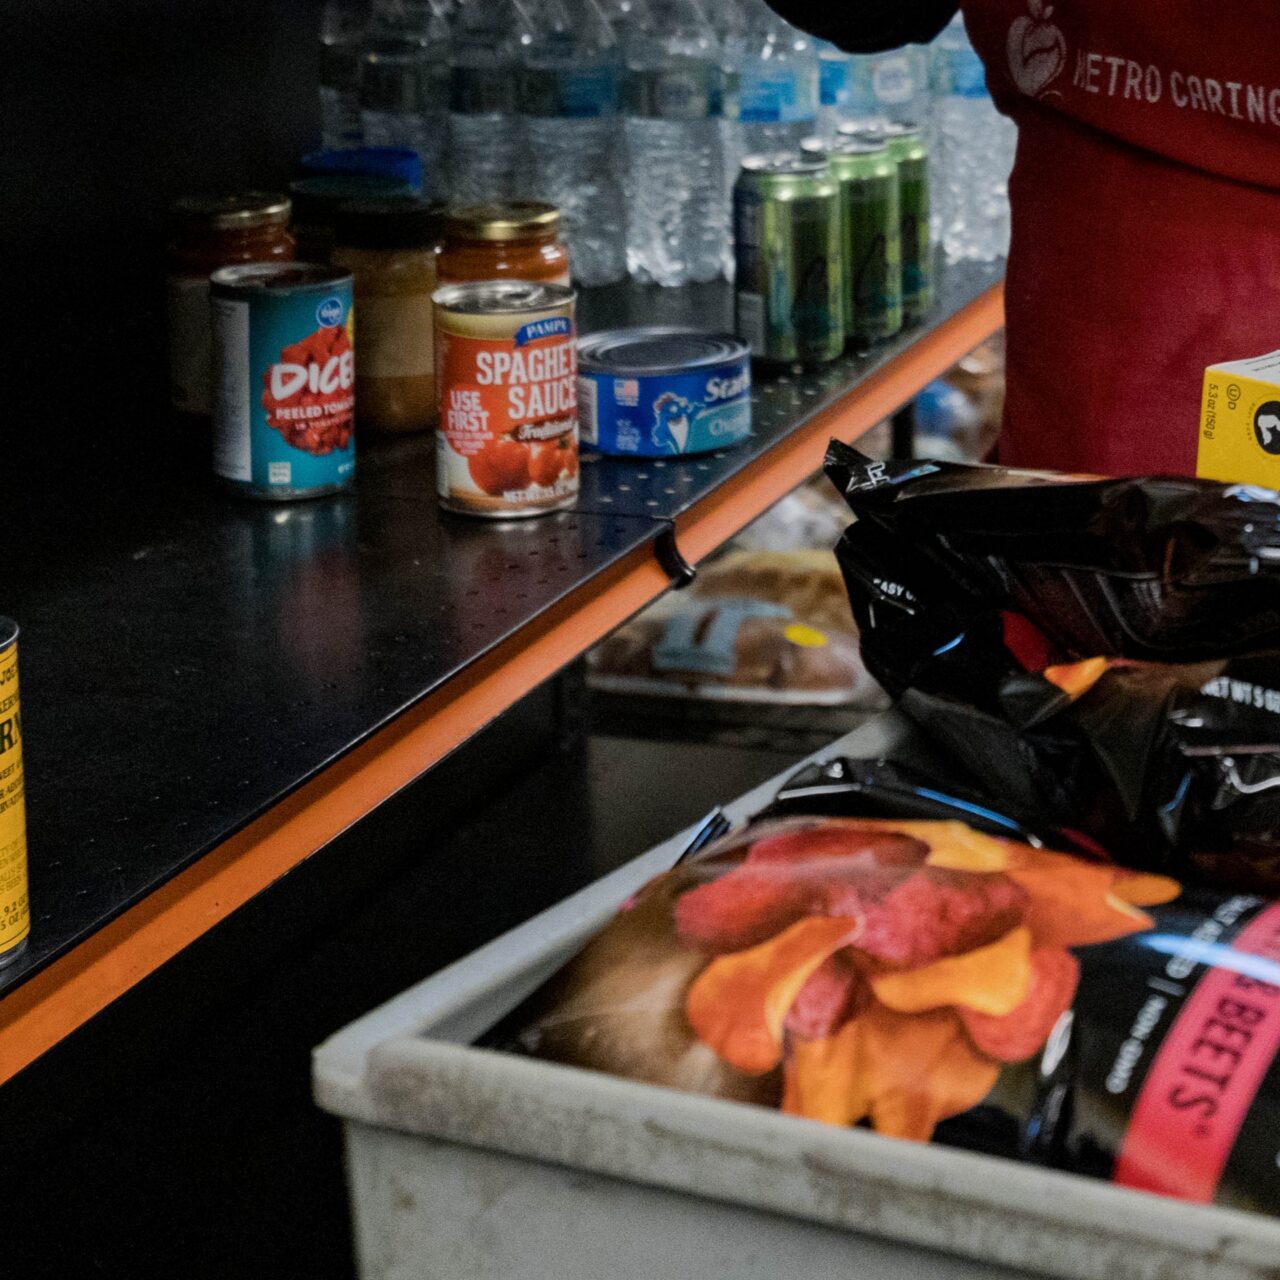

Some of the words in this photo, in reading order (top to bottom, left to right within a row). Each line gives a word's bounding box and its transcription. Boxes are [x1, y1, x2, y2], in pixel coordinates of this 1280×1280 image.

[476, 340, 577, 385] SPAGHET
[508, 375, 577, 419] SAUCE
[1208, 383, 1218, 396] 5.3
[450, 390, 482, 411] USE
[1208, 398, 1216, 409] oz
[275, 406, 323, 420] PEELED
[448, 411, 490, 432] FIRST
[1205, 409, 1216, 430] (150
[1168, 996, 1265, 1118] BEETS
